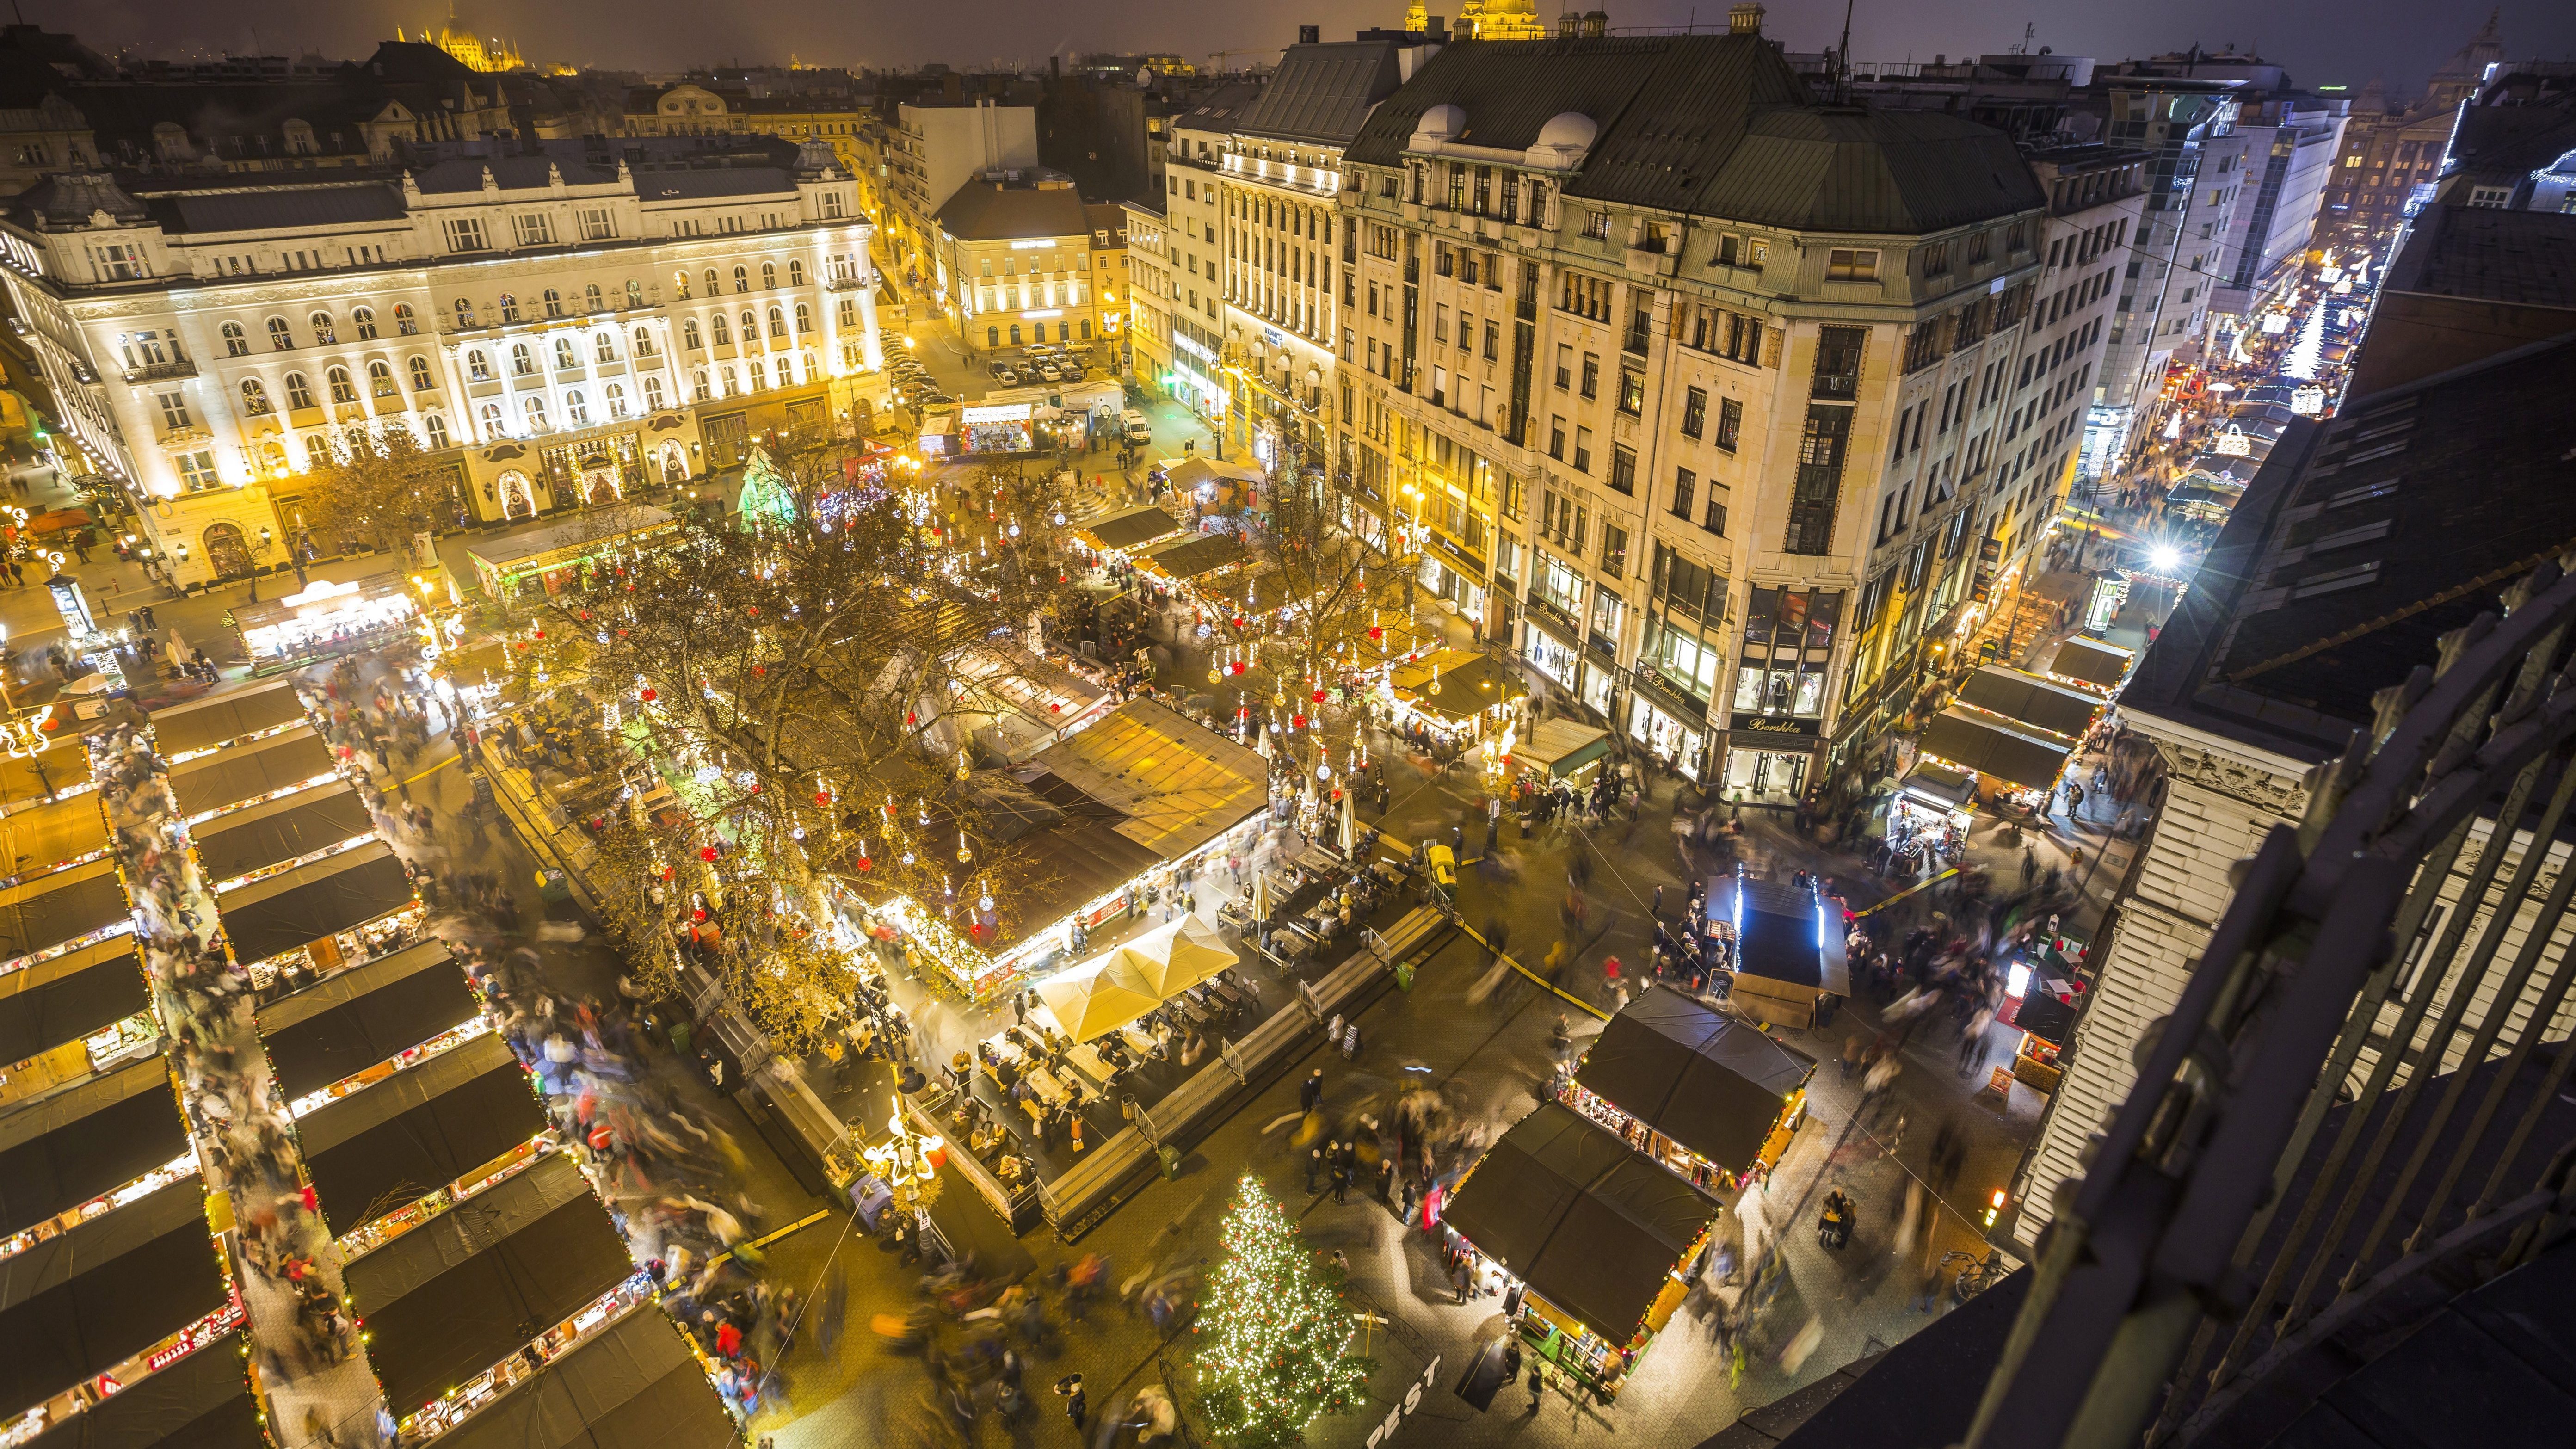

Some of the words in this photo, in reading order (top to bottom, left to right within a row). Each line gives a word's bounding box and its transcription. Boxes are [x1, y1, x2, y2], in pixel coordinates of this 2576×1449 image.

[1539, 602, 1565, 626] Bershka
[1653, 675, 1686, 705] Bershka
[1748, 718, 1801, 733] Bershka
